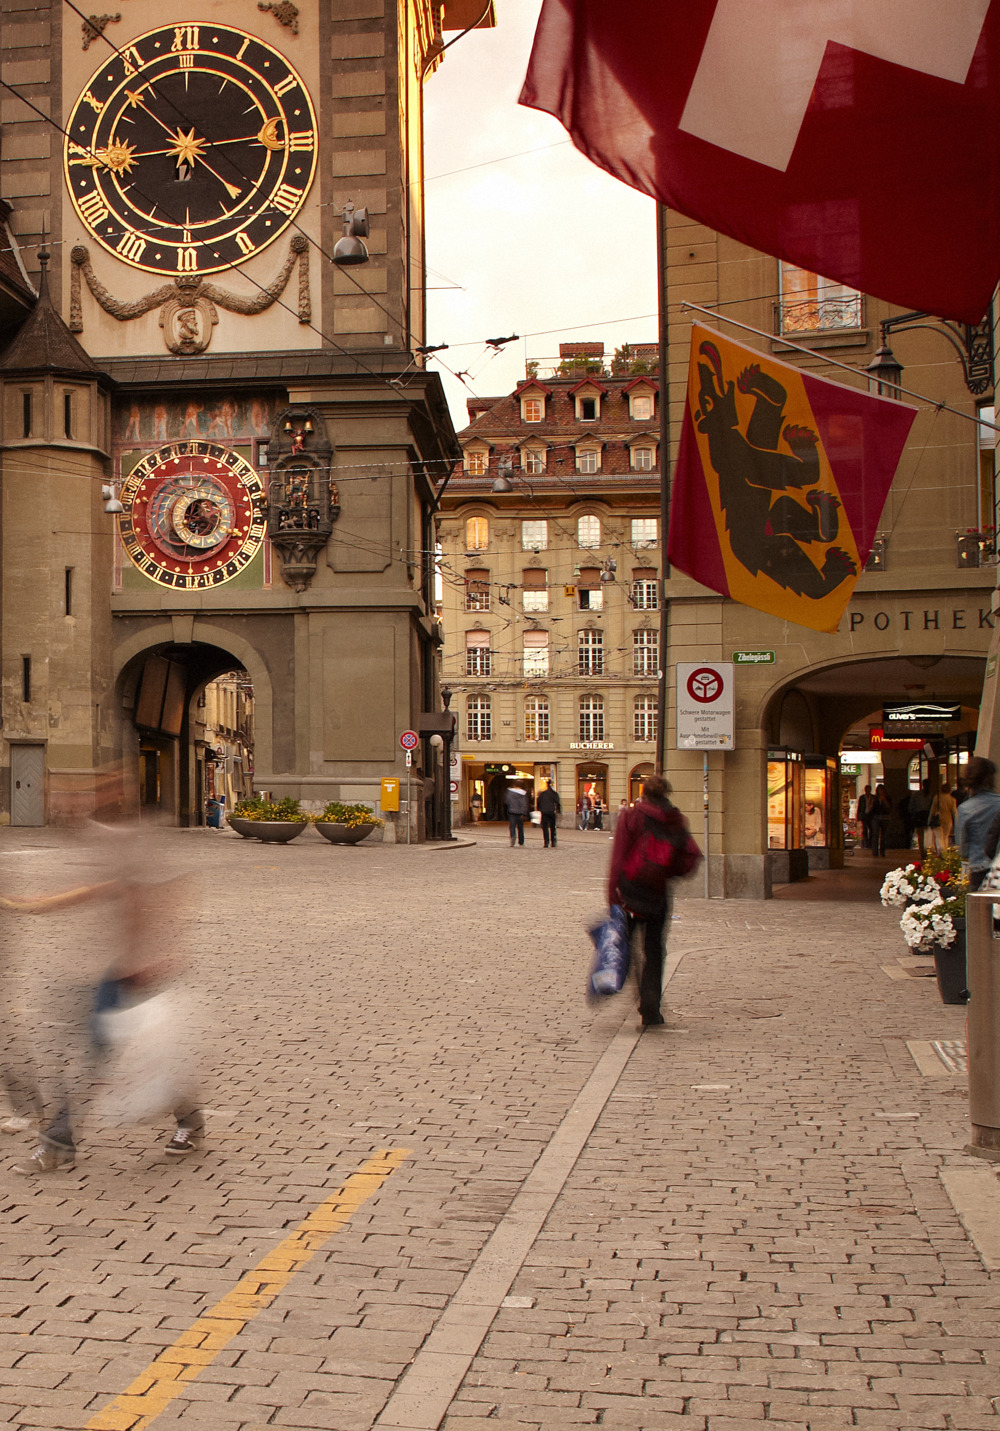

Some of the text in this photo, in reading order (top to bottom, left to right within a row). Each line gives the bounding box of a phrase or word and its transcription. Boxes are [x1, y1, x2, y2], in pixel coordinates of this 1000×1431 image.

[171, 26, 200, 51] XII
[119, 46, 145, 75] XI
[273, 73, 298, 98] II
[289, 129, 314, 152] III
[838, 608, 995, 632] POTHEK
[737, 652, 771, 663] Zibelegässli
[570, 742, 616, 750] BUCHERER
